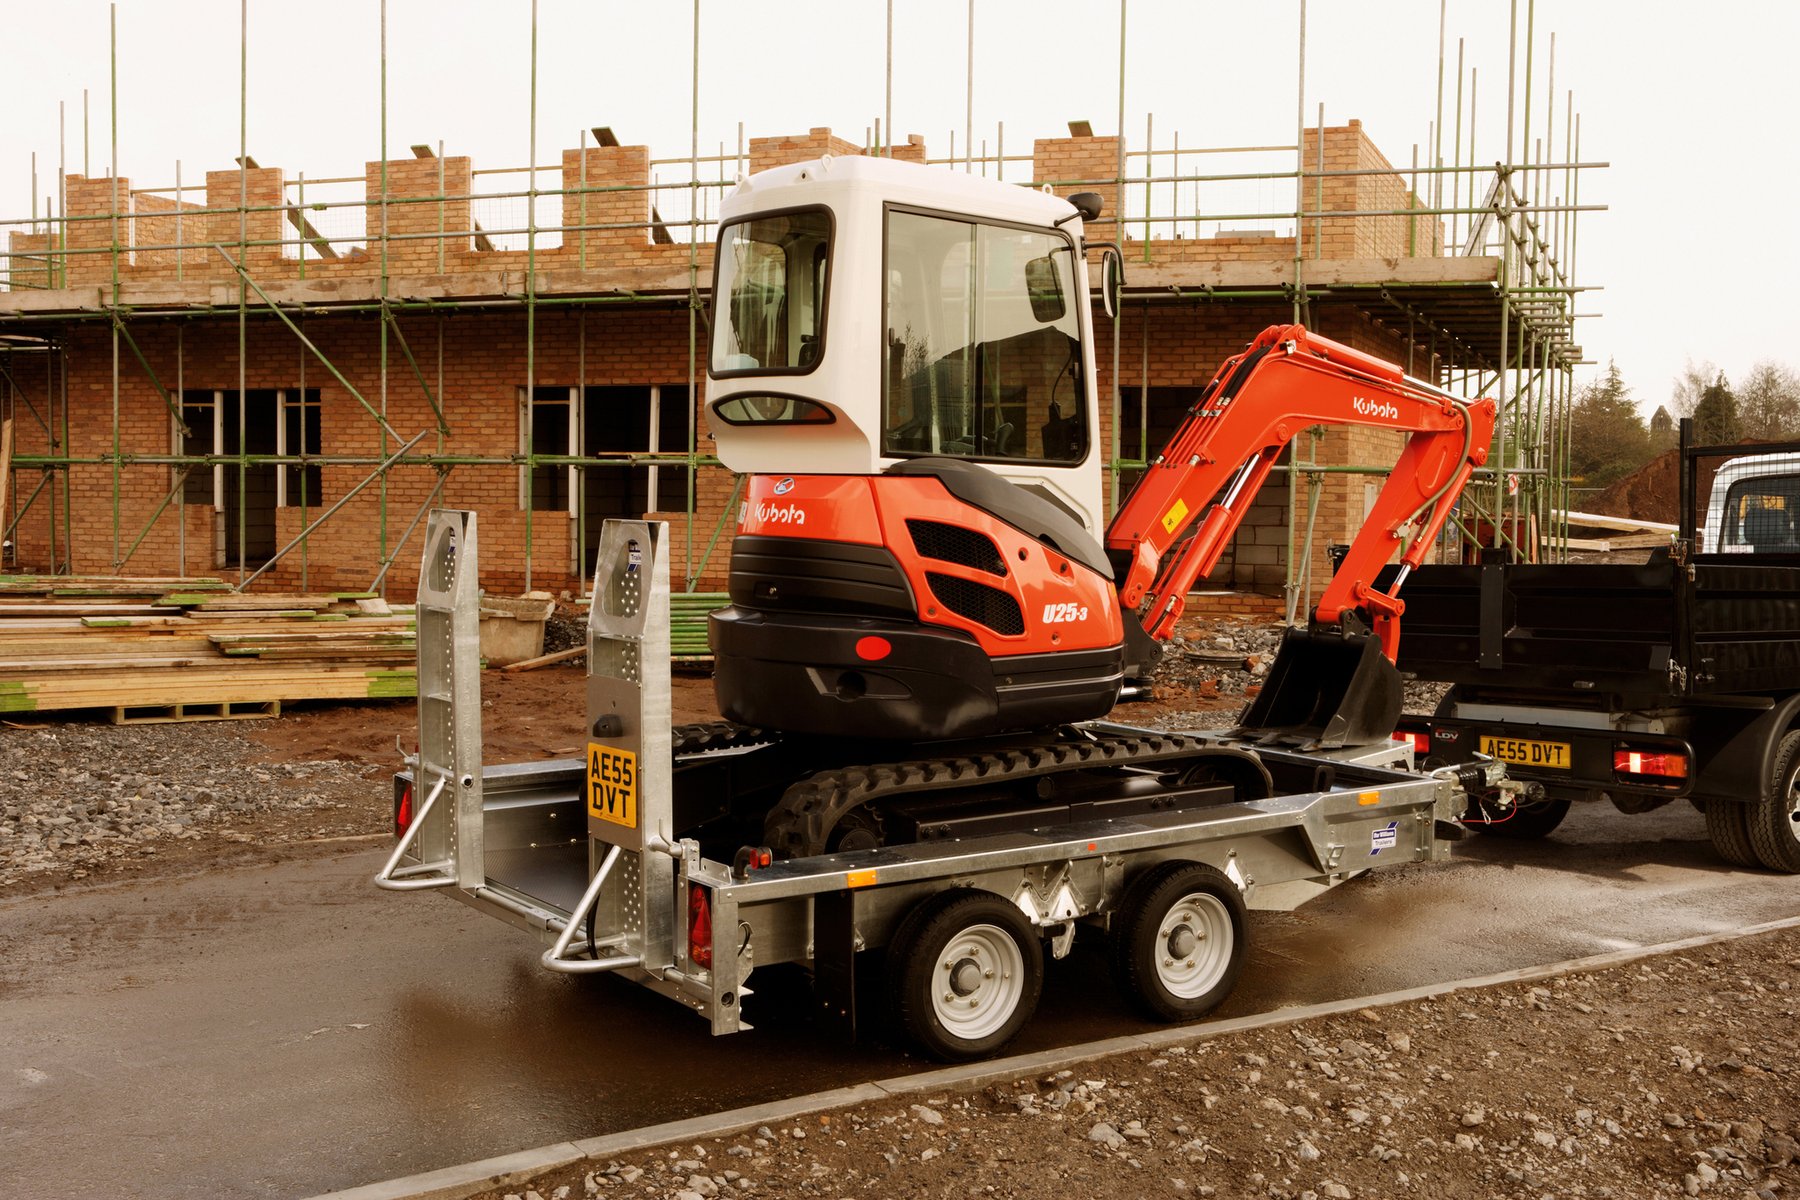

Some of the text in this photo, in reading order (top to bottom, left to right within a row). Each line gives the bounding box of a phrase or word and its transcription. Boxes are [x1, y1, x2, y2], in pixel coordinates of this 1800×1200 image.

[1353, 396, 1398, 419] Kubota
[754, 503, 805, 524] Kubota
[1042, 602, 1088, 624] U25-3
[1435, 732, 1458, 740] LDV
[1487, 739, 1563, 764] AE55 DVT
[591, 750, 632, 787] AE55
[592, 781, 630, 818] DVT
